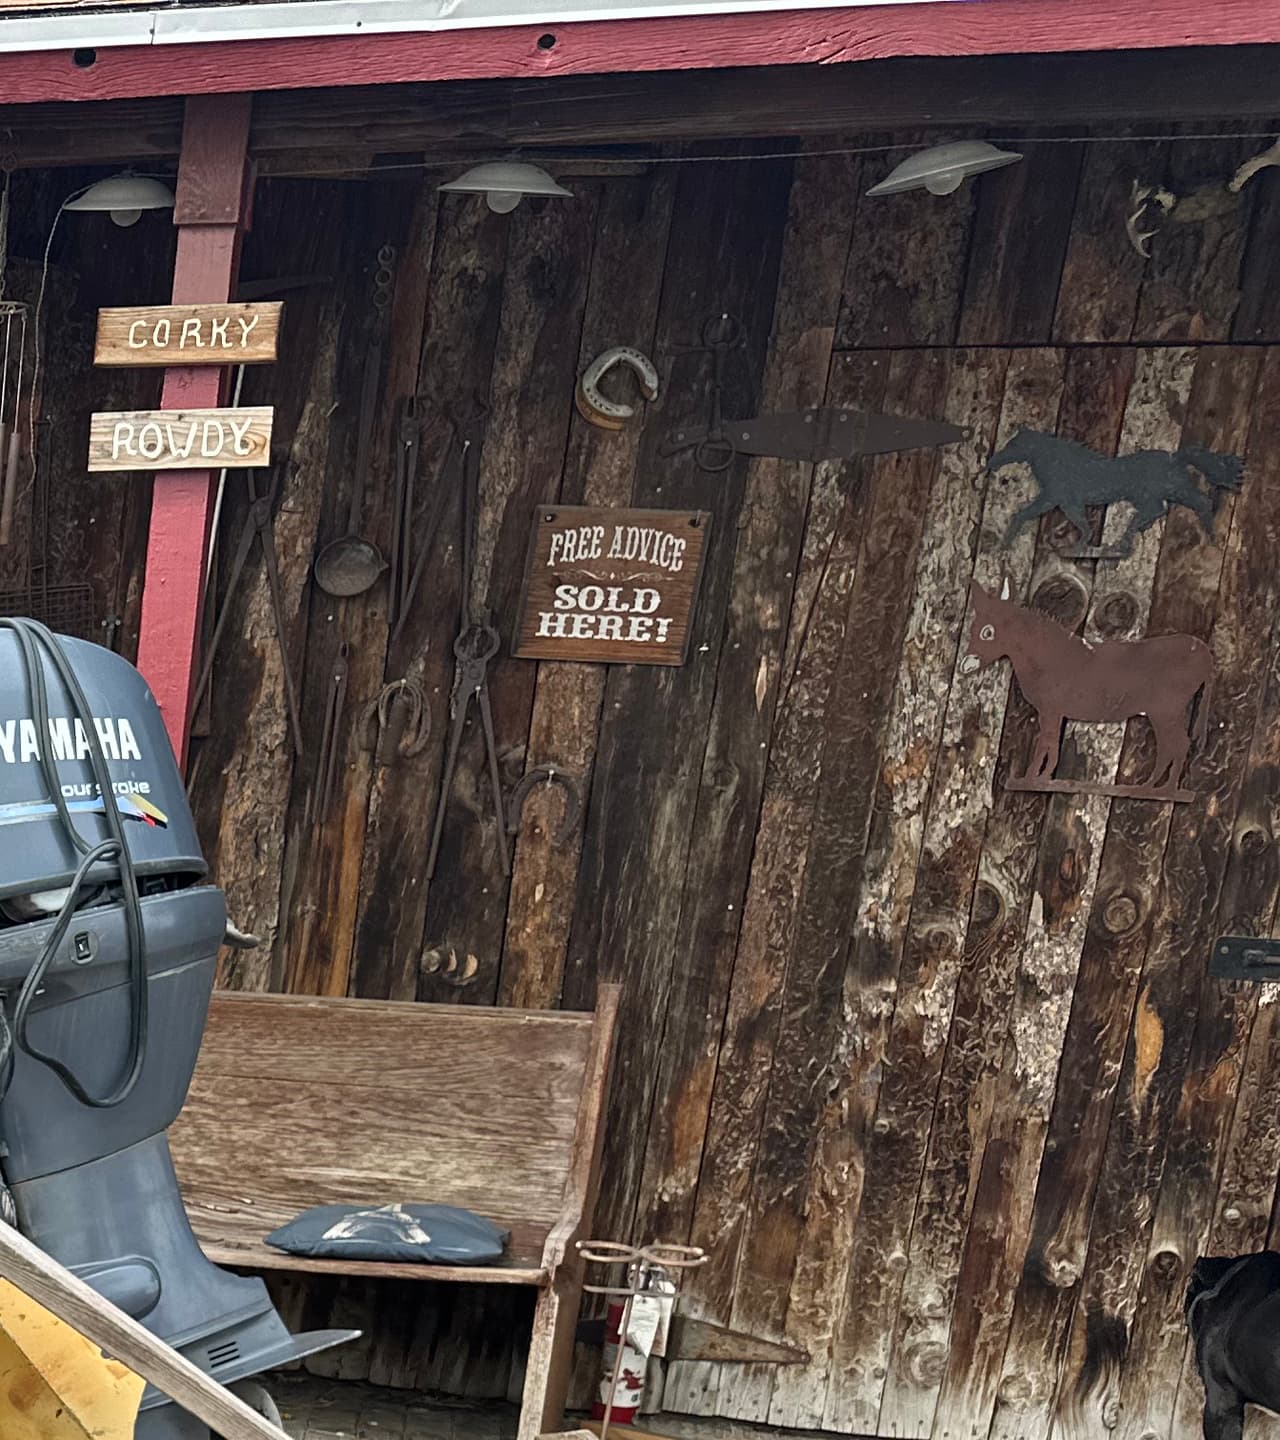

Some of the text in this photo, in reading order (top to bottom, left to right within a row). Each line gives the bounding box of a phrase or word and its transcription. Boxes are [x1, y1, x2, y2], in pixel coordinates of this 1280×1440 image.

[128, 314, 260, 350] CORKY
[111, 416, 253, 460] ROWDY
[546, 525, 687, 573] FREE ADVICE
[553, 584, 662, 614] SOLD
[534, 611, 673, 643] HERE!
